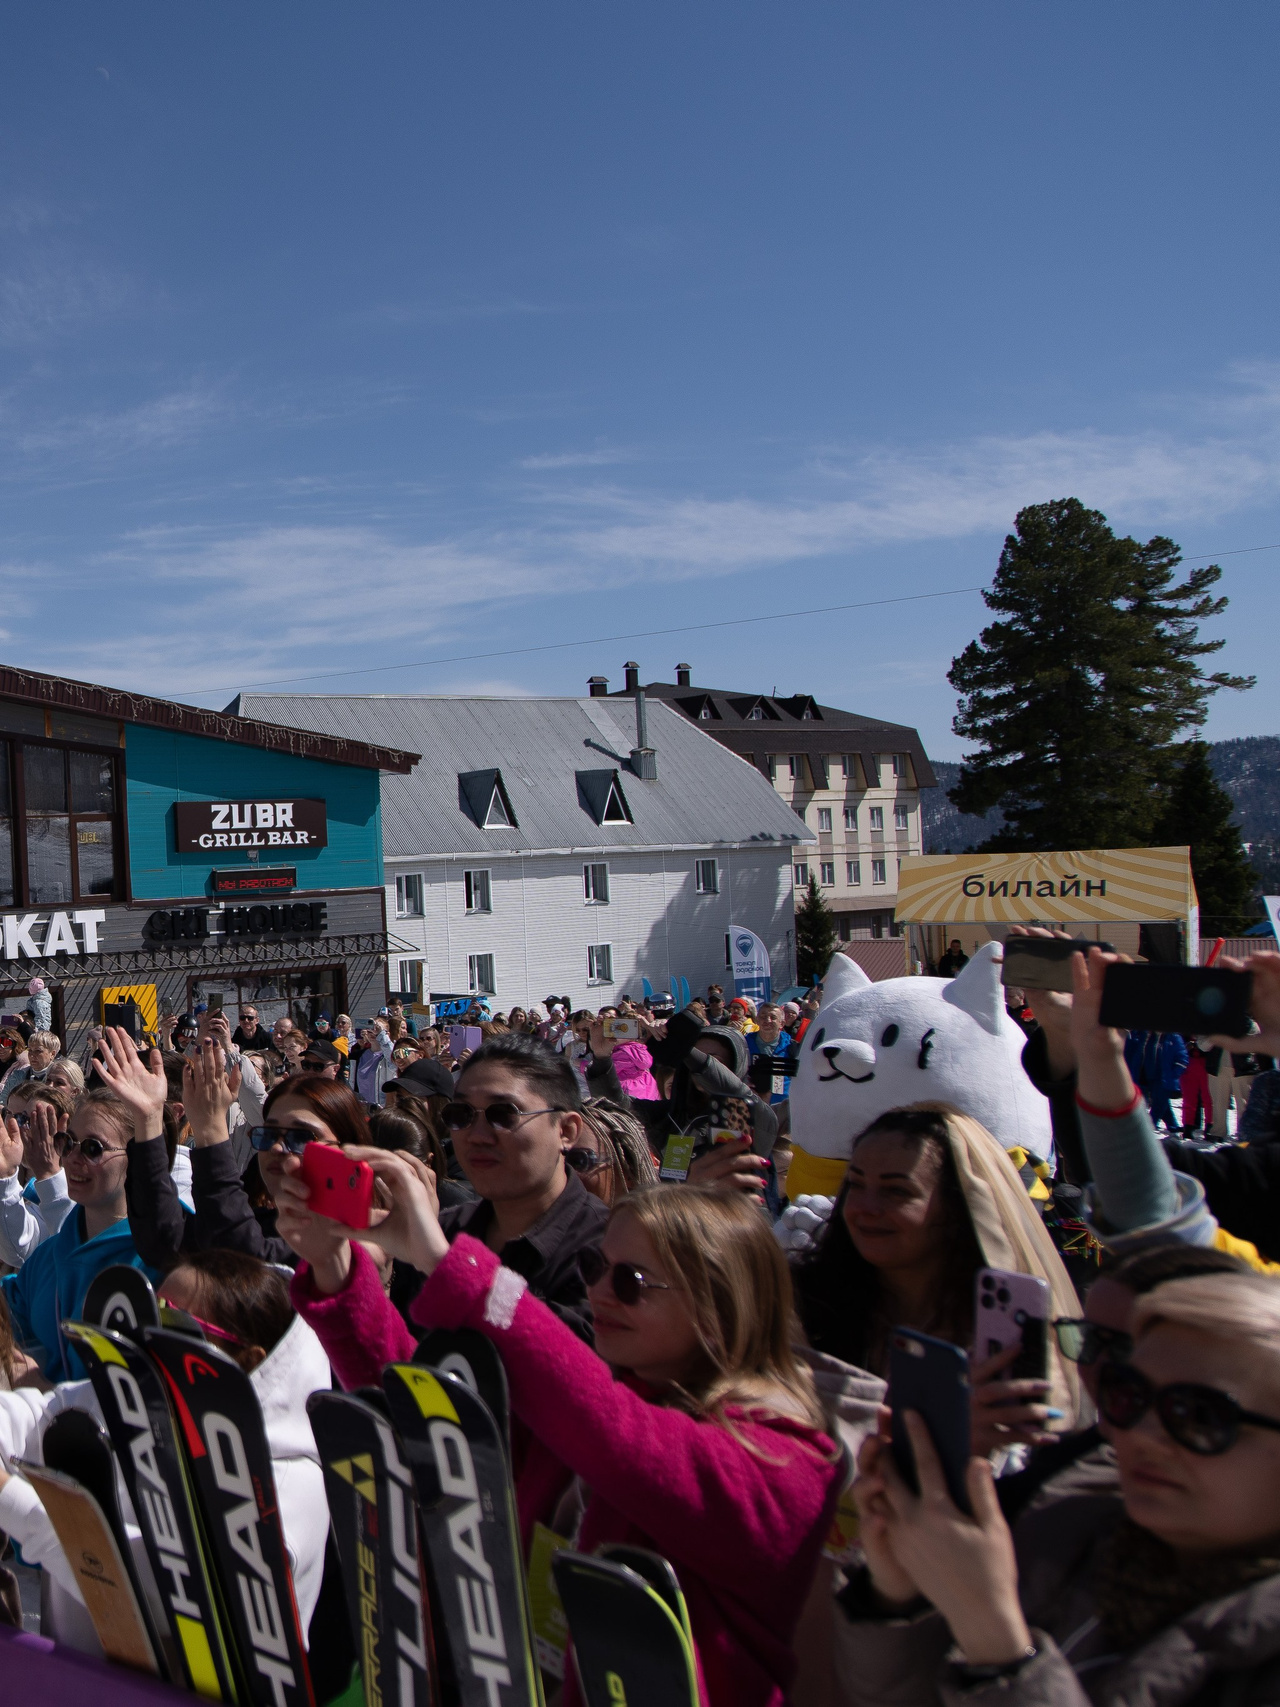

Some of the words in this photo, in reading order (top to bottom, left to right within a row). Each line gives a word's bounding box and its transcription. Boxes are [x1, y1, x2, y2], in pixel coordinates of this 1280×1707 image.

[211, 802, 295, 830] ZUBR
[962, 874, 1106, 898] билайн
[149, 908, 210, 942] SKI
[224, 902, 328, 936] HOUSE
[106, 1364, 202, 1619] HEAD
[203, 1411, 297, 1707] HEAD
[427, 1418, 513, 1707] HEAD
